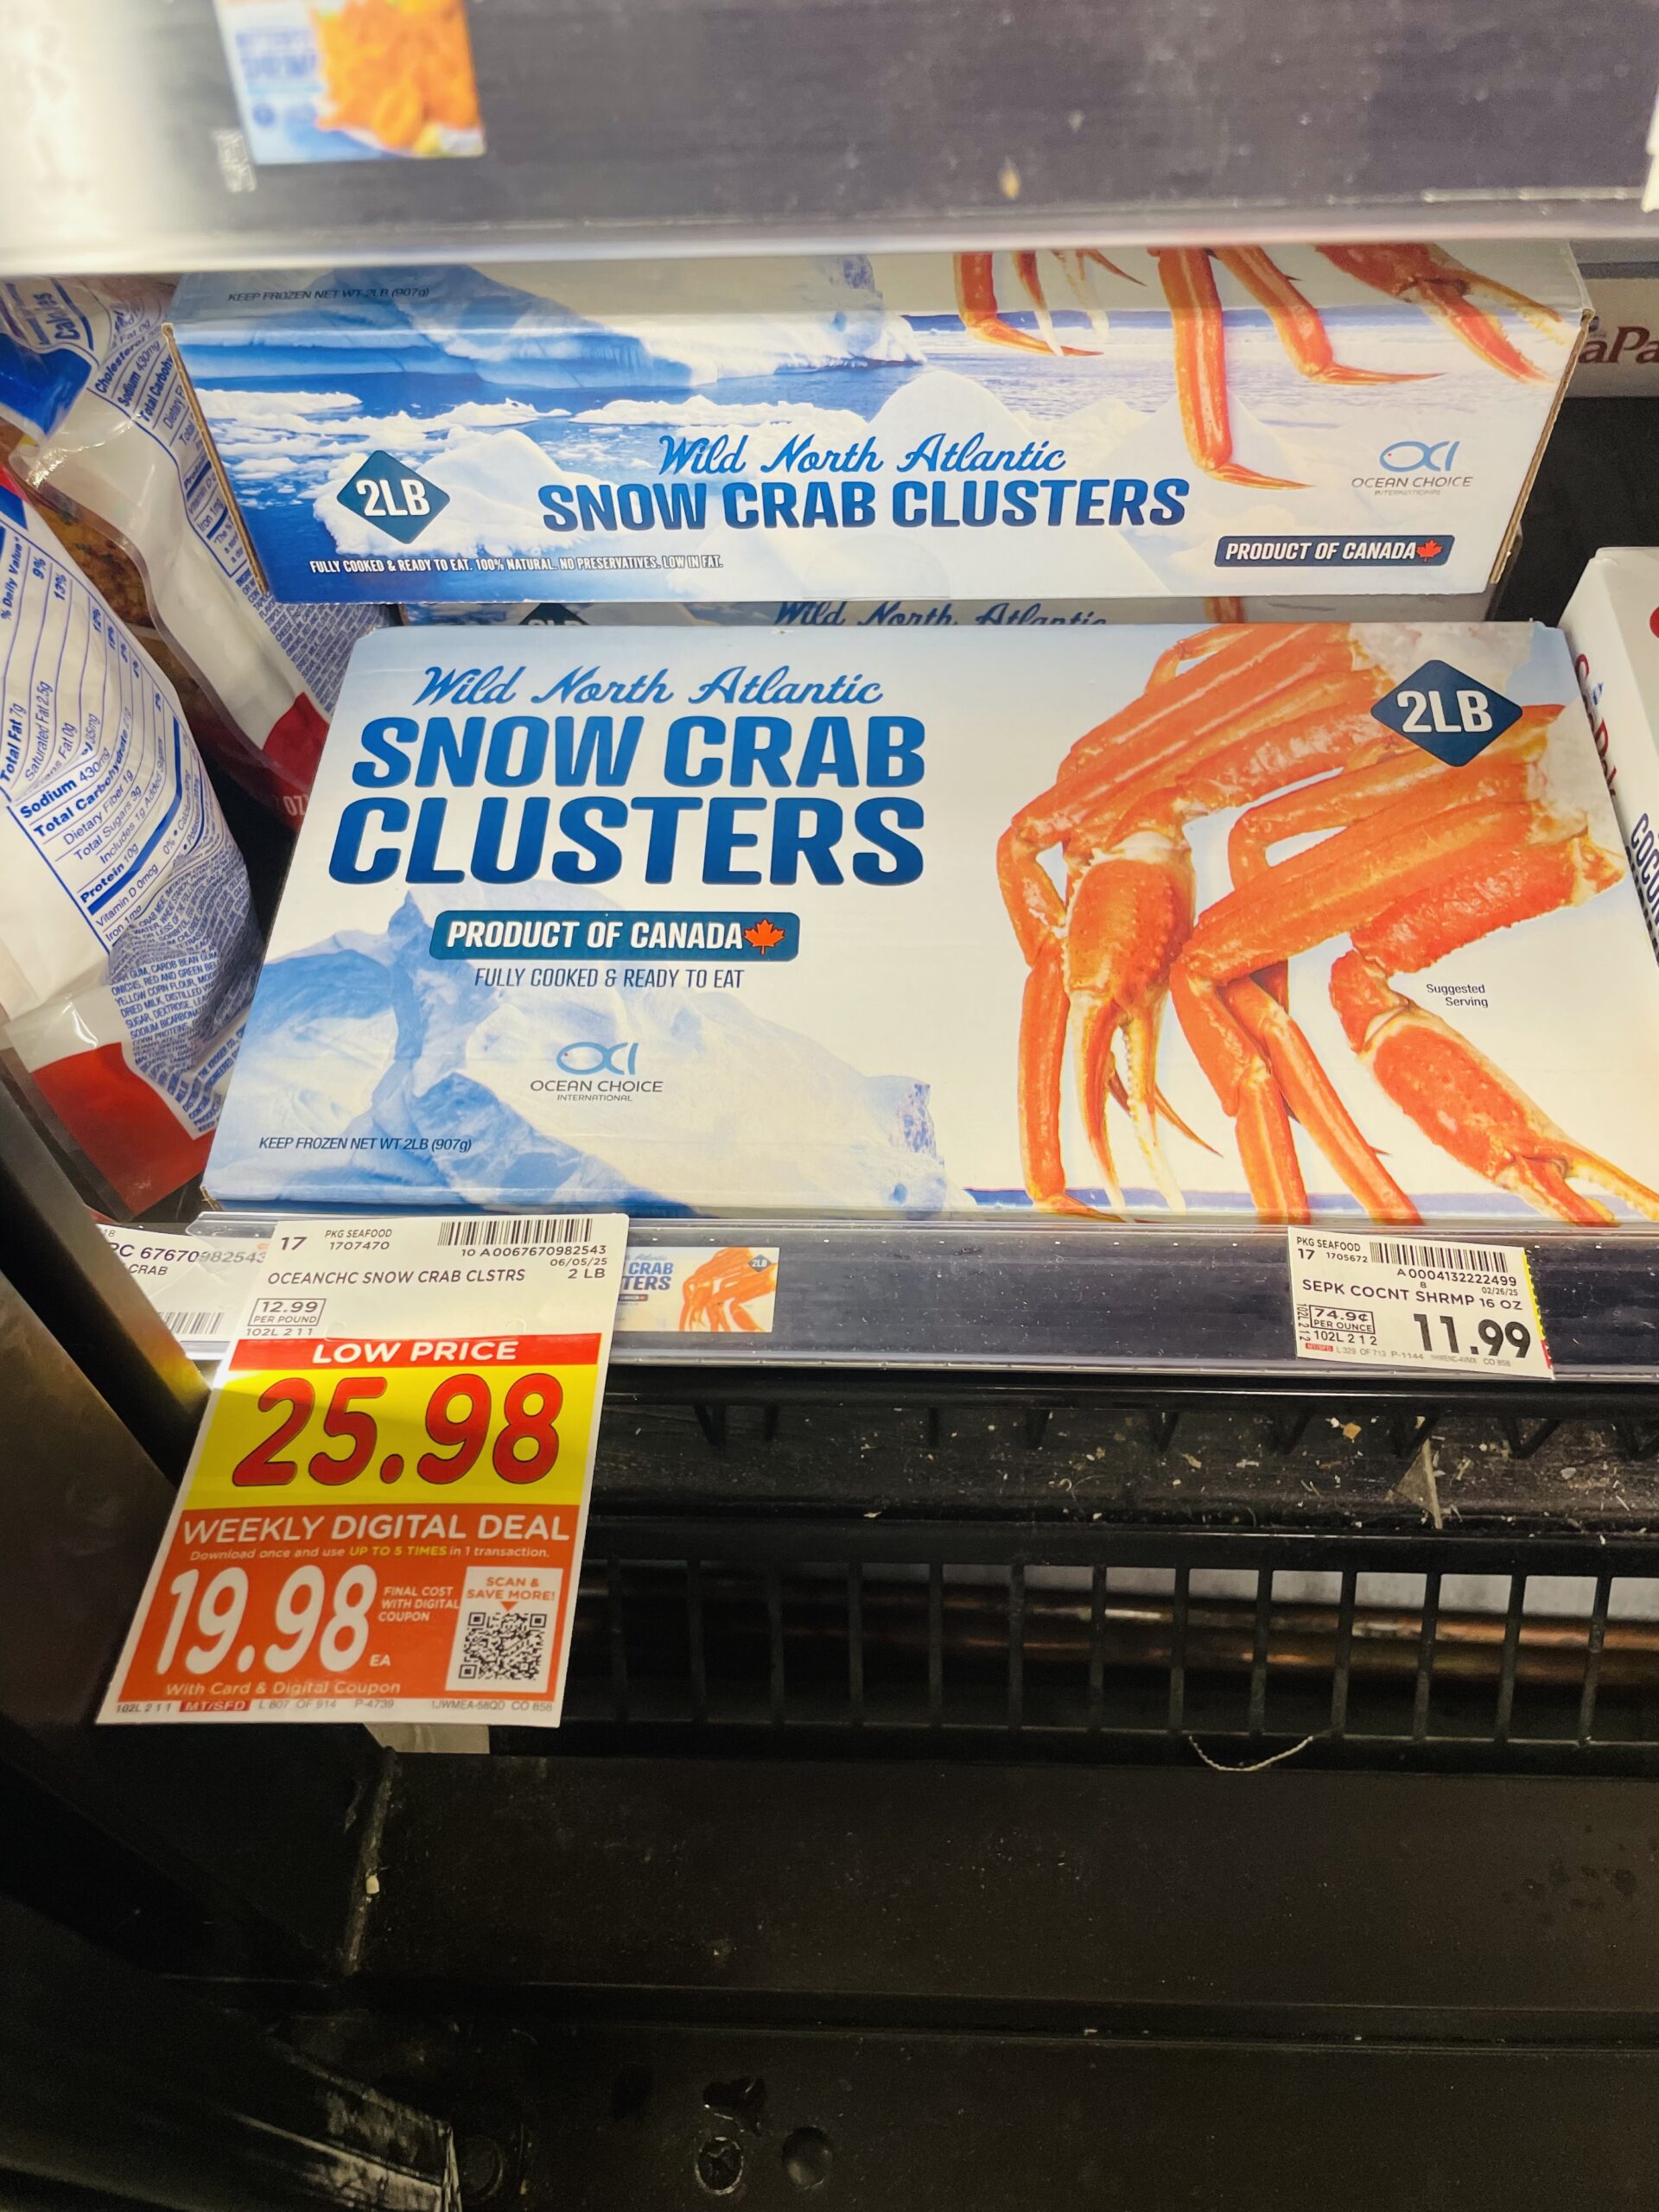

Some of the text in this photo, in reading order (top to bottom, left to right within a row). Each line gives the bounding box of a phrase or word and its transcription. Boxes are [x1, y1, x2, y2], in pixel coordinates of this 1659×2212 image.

[229, 291, 259, 301] KEEP
[263, 290, 310, 300] FROZEN
[315, 289, 338, 298] NET
[392, 288, 429, 297] (907g)
[117, 372, 142, 407] Sodium
[136, 340, 161, 372] 430mg
[140, 391, 158, 423] Total
[162, 397, 183, 429] Dietary
[658, 432, 1066, 475] Wild North Atlantic
[1351, 476, 1473, 488] OCEAN CHOICE
[356, 479, 431, 518] 2LB
[537, 478, 1190, 531] SNOW CRAB CLUSTERS
[198, 514, 213, 532] Iron
[1225, 542, 1416, 560] PRODUCT OF CANADA
[33, 557, 46, 580] 9%
[310, 555, 723, 572] FULLY COOKED & READY TO EAT. 100% NATURAL. NO PRESERVATIVES. LOW IN FAT.
[54, 574, 67, 601] 13%
[1, 578, 17, 620] % Daily
[412, 665, 883, 706] Wild North Atlantic
[35, 705, 49, 724] Fat
[1397, 690, 1493, 733] 2LB
[0, 702, 27, 782] Total Fat 7g
[58, 737, 73, 760] Fat
[25, 722, 49, 781] Saturated
[351, 715, 925, 788] SNOW CRAB
[20, 779, 78, 818] Sodium
[79, 747, 111, 782] 430mg
[33, 809, 74, 838] Total
[75, 729, 129, 811] Carbohydrate
[62, 785, 124, 846] Dietary Fiber
[73, 803, 132, 861] Total Sugars
[99, 806, 147, 864] Includes 1g
[328, 796, 925, 887] CLUSTERS
[79, 842, 139, 903] Protein 10g
[96, 863, 159, 928] Vitamin 0mcg
[105, 922, 124, 942] Iron
[447, 920, 742, 950] PRODUCT OF CANADA
[474, 968, 745, 988] FULLY COOKED & READY TO EAT
[165, 986, 201, 1001] DISTILLED
[1426, 983, 1485, 995] Suggested
[1445, 997, 1488, 1008] Serving
[530, 1080, 664, 1093] OCEAN CHOICE
[259, 1137, 472, 1153] KEEP FROZEN NET WT 2LB (907g)
[346, 1229, 392, 1237] SEAFOOD
[280, 1237, 307, 1250] 17
[329, 1242, 390, 1250] 1707470
[461, 1245, 607, 1257] 10 A0067670982543
[1297, 1236, 1360, 1251] PKG SEAFOOD
[550, 1258, 607, 1267] 06/05/25
[751, 1258, 768, 1268] 2LB
[1298, 1249, 1368, 1263] 17 1705672
[130, 1264, 168, 1274] CRAB
[268, 1268, 605, 1285] OCEANCHC SNOW CRAB CLSTRS 2 LB
[628, 1262, 674, 1274] CRAB
[1397, 1268, 1516, 1286] A0004132222499
[1302, 1279, 1522, 1310] SEPK COCNT SHRMP 16 OZ
[1482, 1287, 1518, 1296] 02/26/25
[262, 1301, 318, 1313] 12.99
[1315, 1308, 1369, 1322] 74.9¢
[1313, 1319, 1372, 1332] PER OUNCE
[1314, 1331, 1377, 1345] 102L 2 1 2
[1413, 1313, 1530, 1358] 11.99
[312, 1340, 519, 1363] LOW PRICE
[232, 1372, 563, 1487] 25.98
[184, 1514, 570, 1545] WEEKLY DIGITAL DEAL
[190, 1546, 550, 1560] Download once and use UP TO 5 TIMES in 1 transaction.
[385, 1586, 454, 1596] FINAL COST
[486, 1577, 539, 1587] SCAN &
[381, 1599, 460, 1609] WITH DIGITAL
[467, 1589, 555, 1601] SAVE MORE!
[156, 1564, 378, 1675] 19.98
[378, 1611, 430, 1622] COUPON
[370, 1655, 391, 1667] EA
[166, 1681, 401, 1696] With Card & Digital Coupon
[185, 1700, 246, 1711] MT/SFD
[269, 1700, 336, 1709] 807 OF 914
[354, 1700, 530, 1711] P-4739 CO
